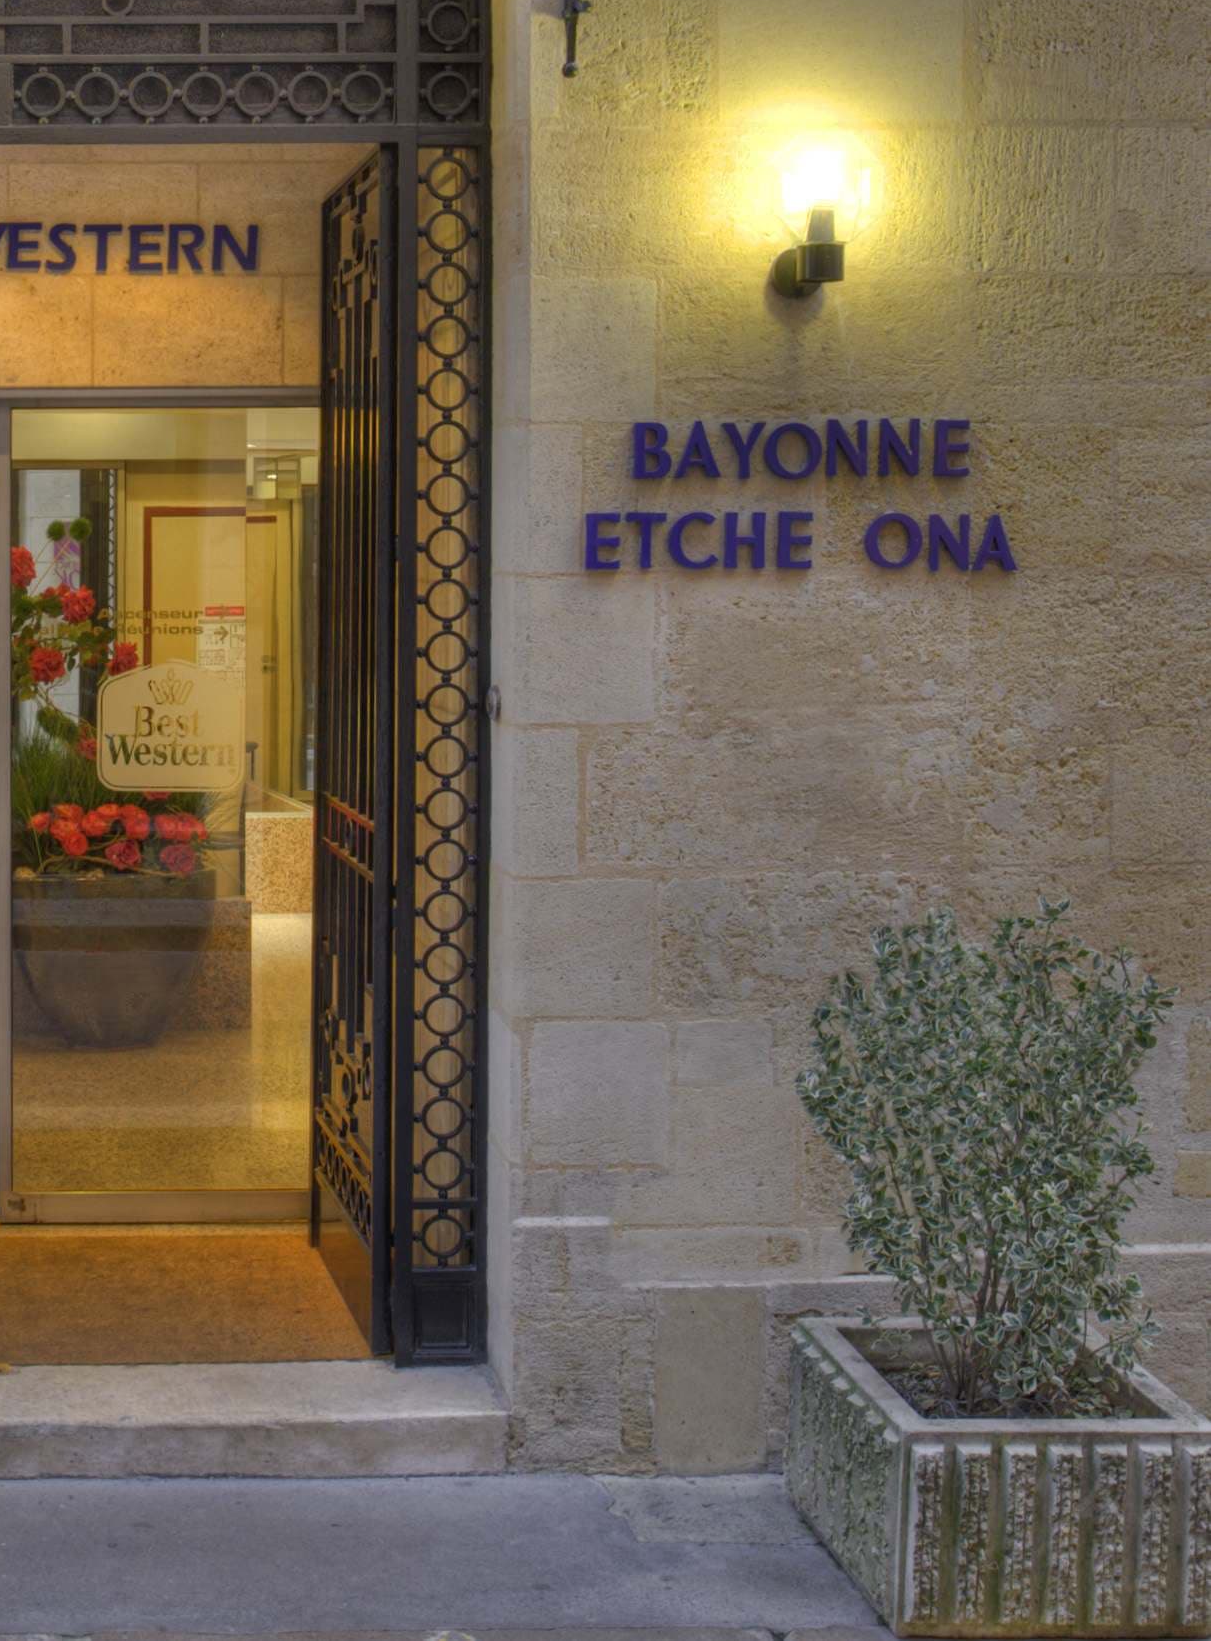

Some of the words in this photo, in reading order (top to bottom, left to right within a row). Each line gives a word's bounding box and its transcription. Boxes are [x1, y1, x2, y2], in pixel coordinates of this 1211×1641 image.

[631, 418, 970, 479] BAYONNE
[585, 511, 814, 571] ETCHE
[864, 512, 1018, 572] ONA
[134, 705, 204, 738] Best
[105, 733, 238, 766] Western
